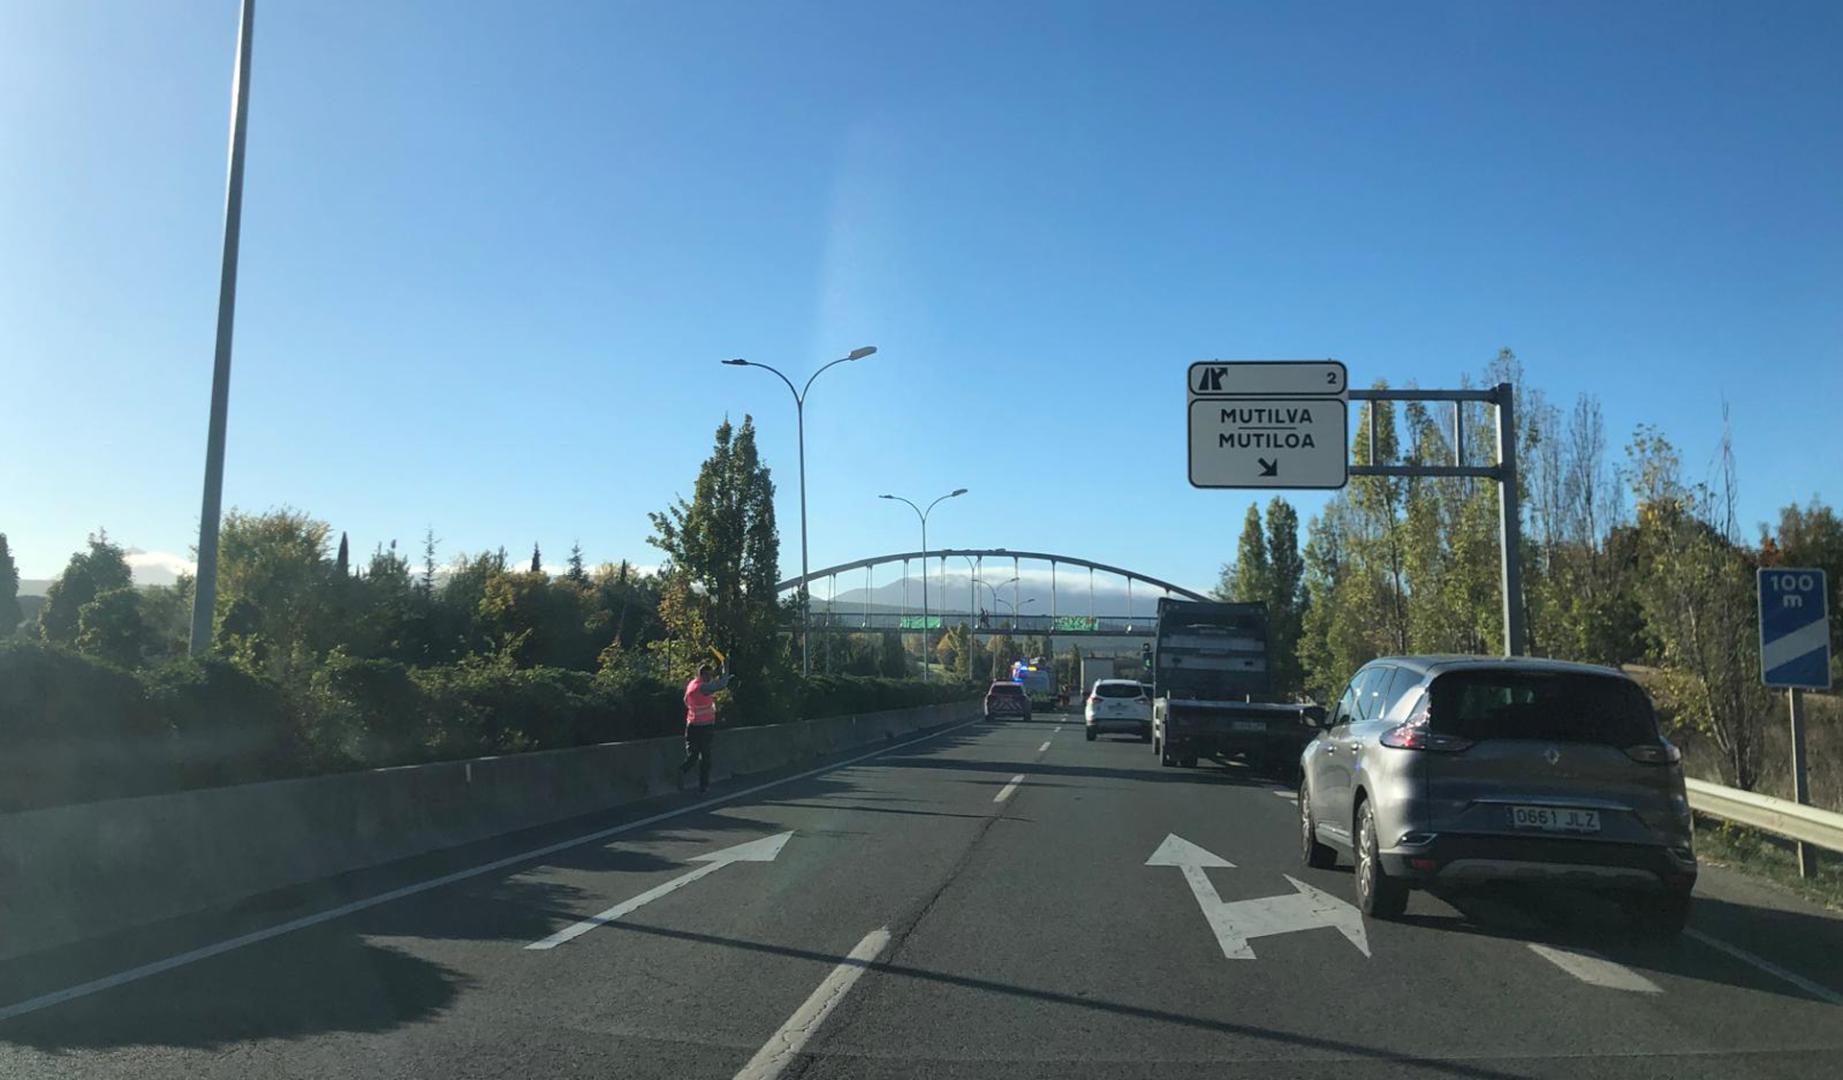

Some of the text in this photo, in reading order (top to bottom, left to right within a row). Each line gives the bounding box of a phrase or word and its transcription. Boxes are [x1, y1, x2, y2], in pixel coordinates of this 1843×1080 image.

[1327, 372, 1337, 384] 2
[1220, 408, 1313, 424] MUTILVA
[1219, 433, 1315, 449] MUTILOA
[1770, 574, 1814, 592] 100
[1783, 595, 1803, 608] m
[1565, 811, 1596, 829] JLZ
